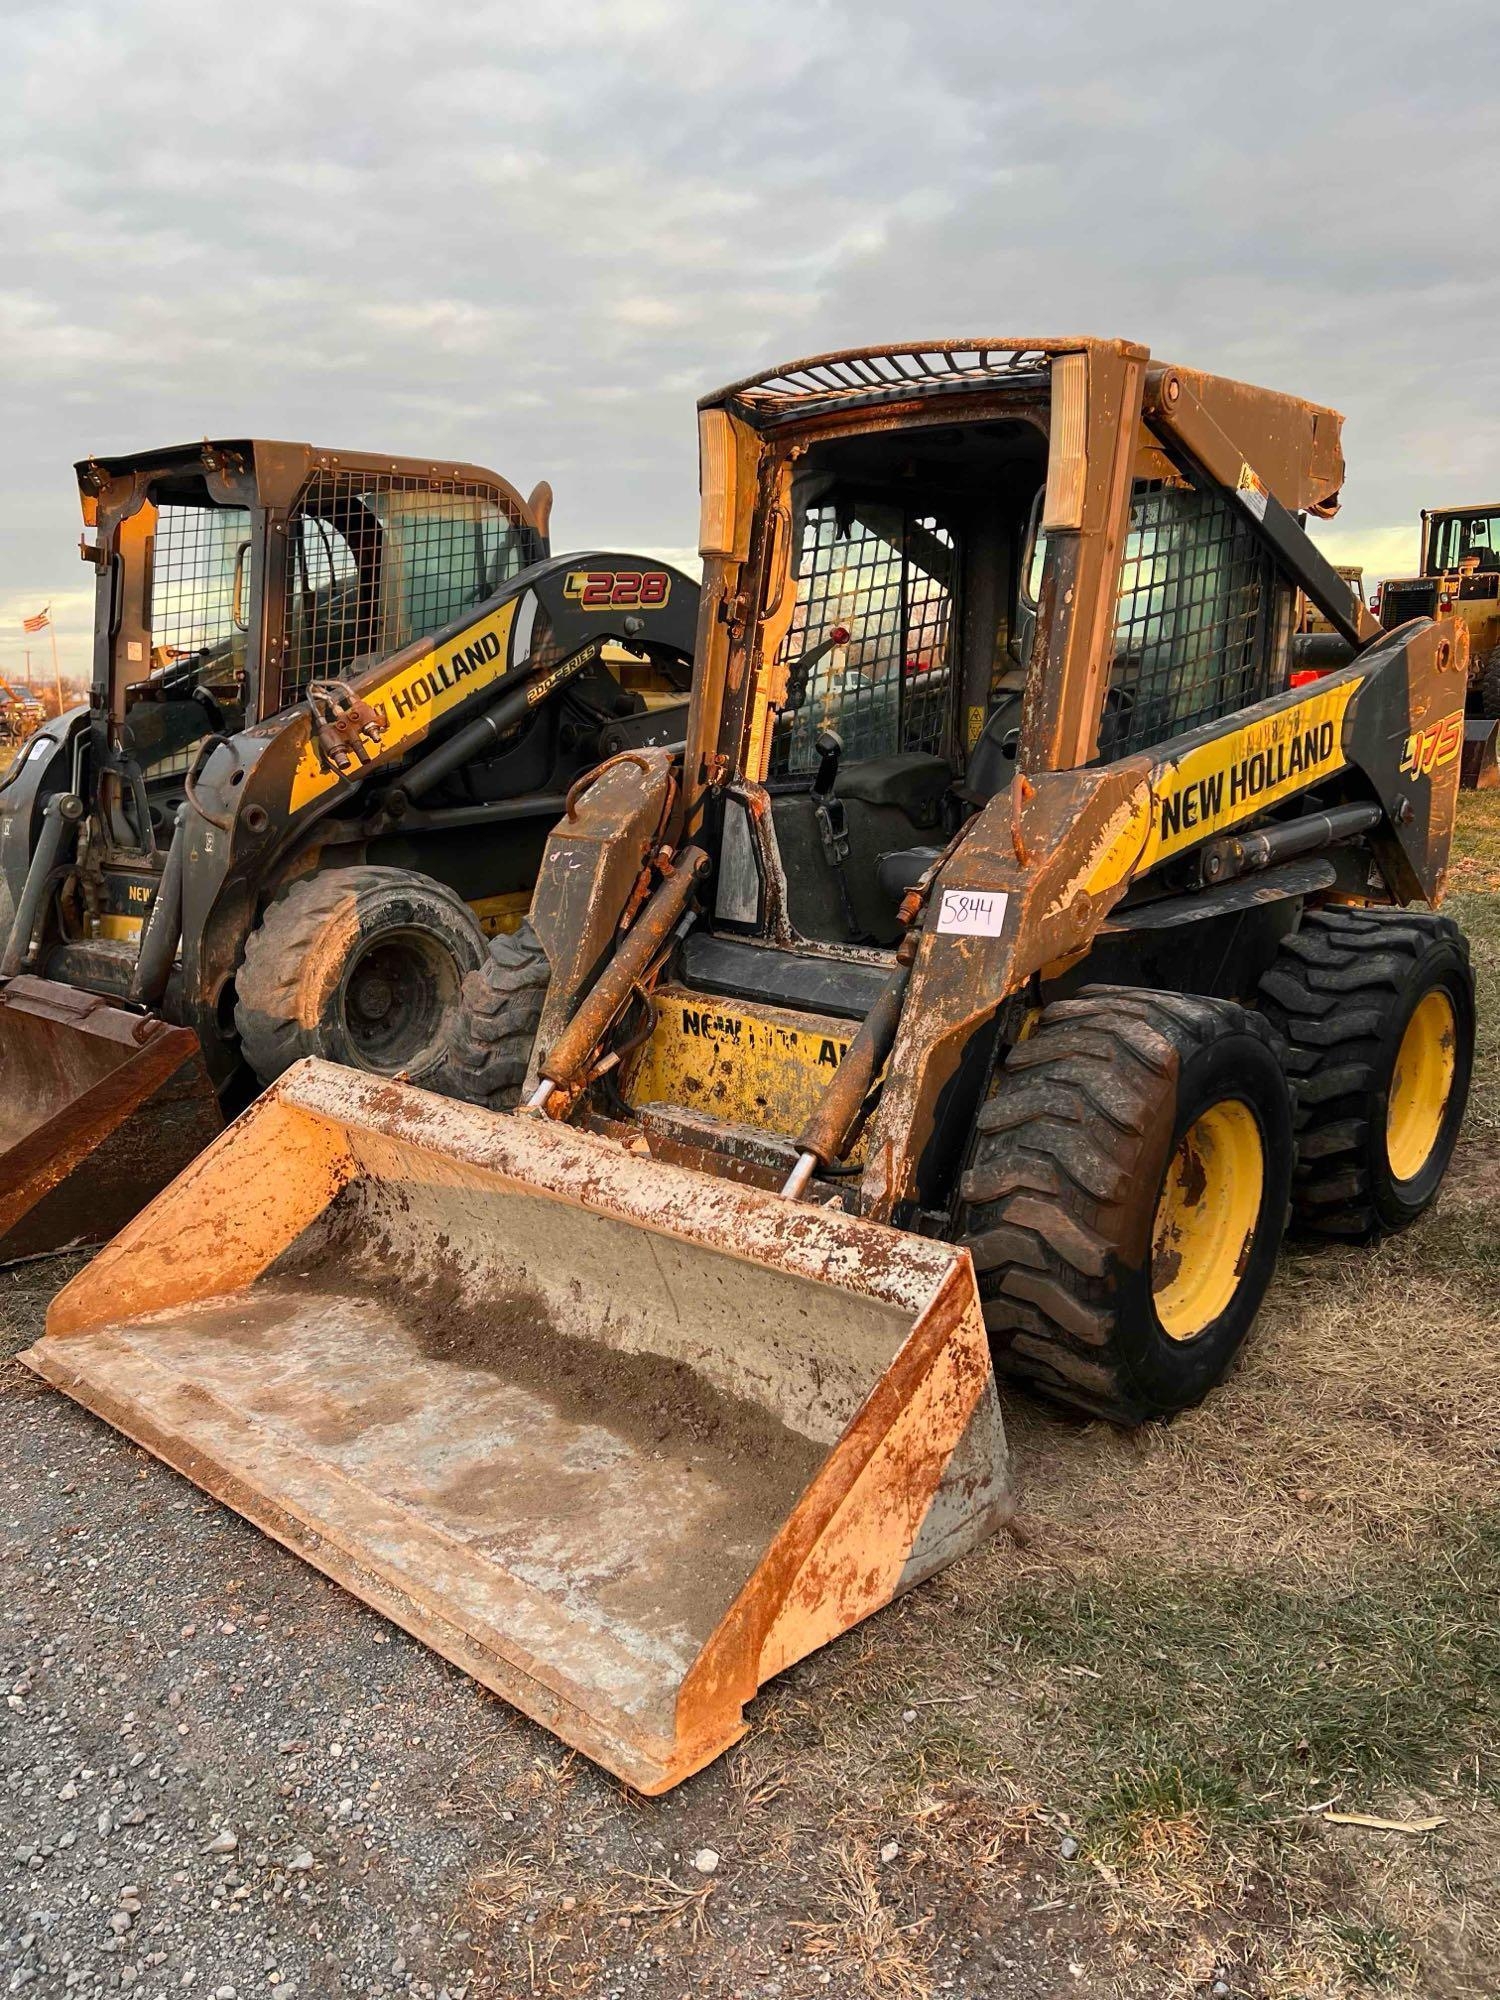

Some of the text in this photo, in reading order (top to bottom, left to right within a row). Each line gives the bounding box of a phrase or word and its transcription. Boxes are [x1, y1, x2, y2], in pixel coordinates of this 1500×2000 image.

[563, 571, 672, 611] L228
[391, 631, 501, 719] HOLLAND
[1400, 709, 1464, 781] L175
[1161, 720, 1334, 841] NEW HOLLAND
[129, 886, 152, 902] NEW
[941, 895, 994, 925] 5844
